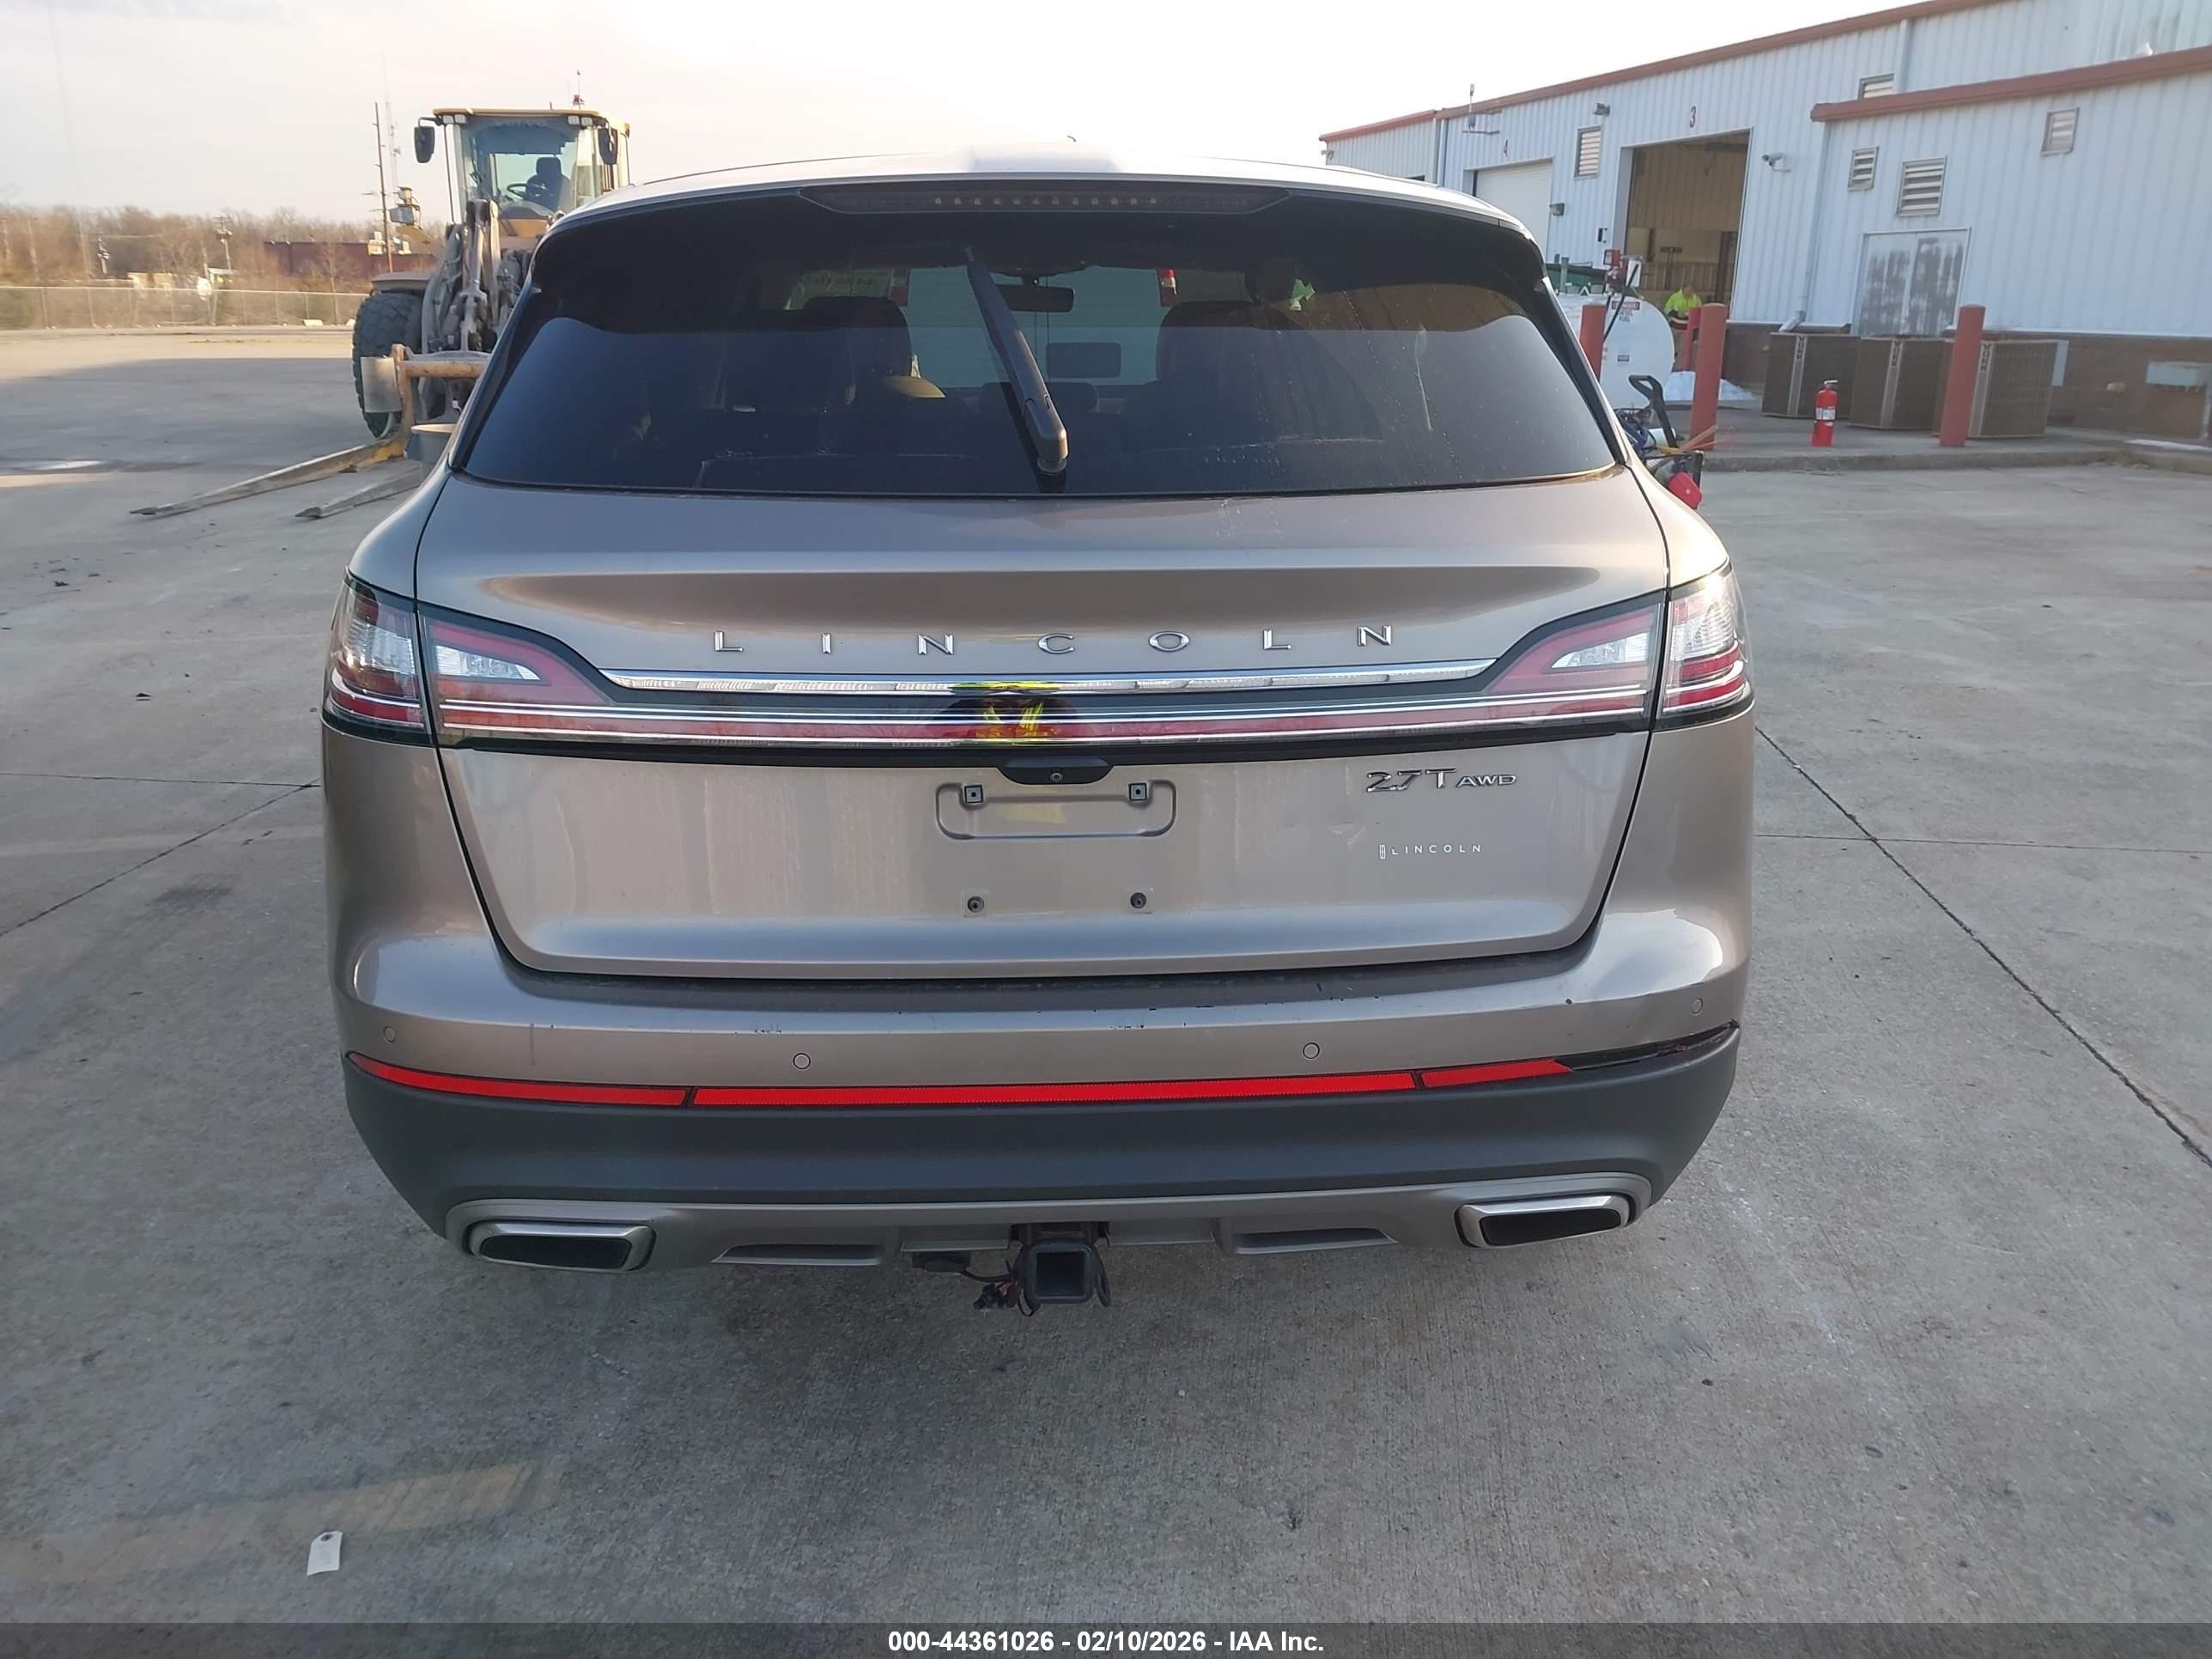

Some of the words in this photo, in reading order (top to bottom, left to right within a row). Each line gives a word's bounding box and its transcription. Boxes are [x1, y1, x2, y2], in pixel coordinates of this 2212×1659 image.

[1689, 105, 1697, 129] 3
[714, 624, 1393, 656] LINCOLN
[1456, 774, 1517, 787] AWD
[1392, 844, 1481, 855] LINCOLN
